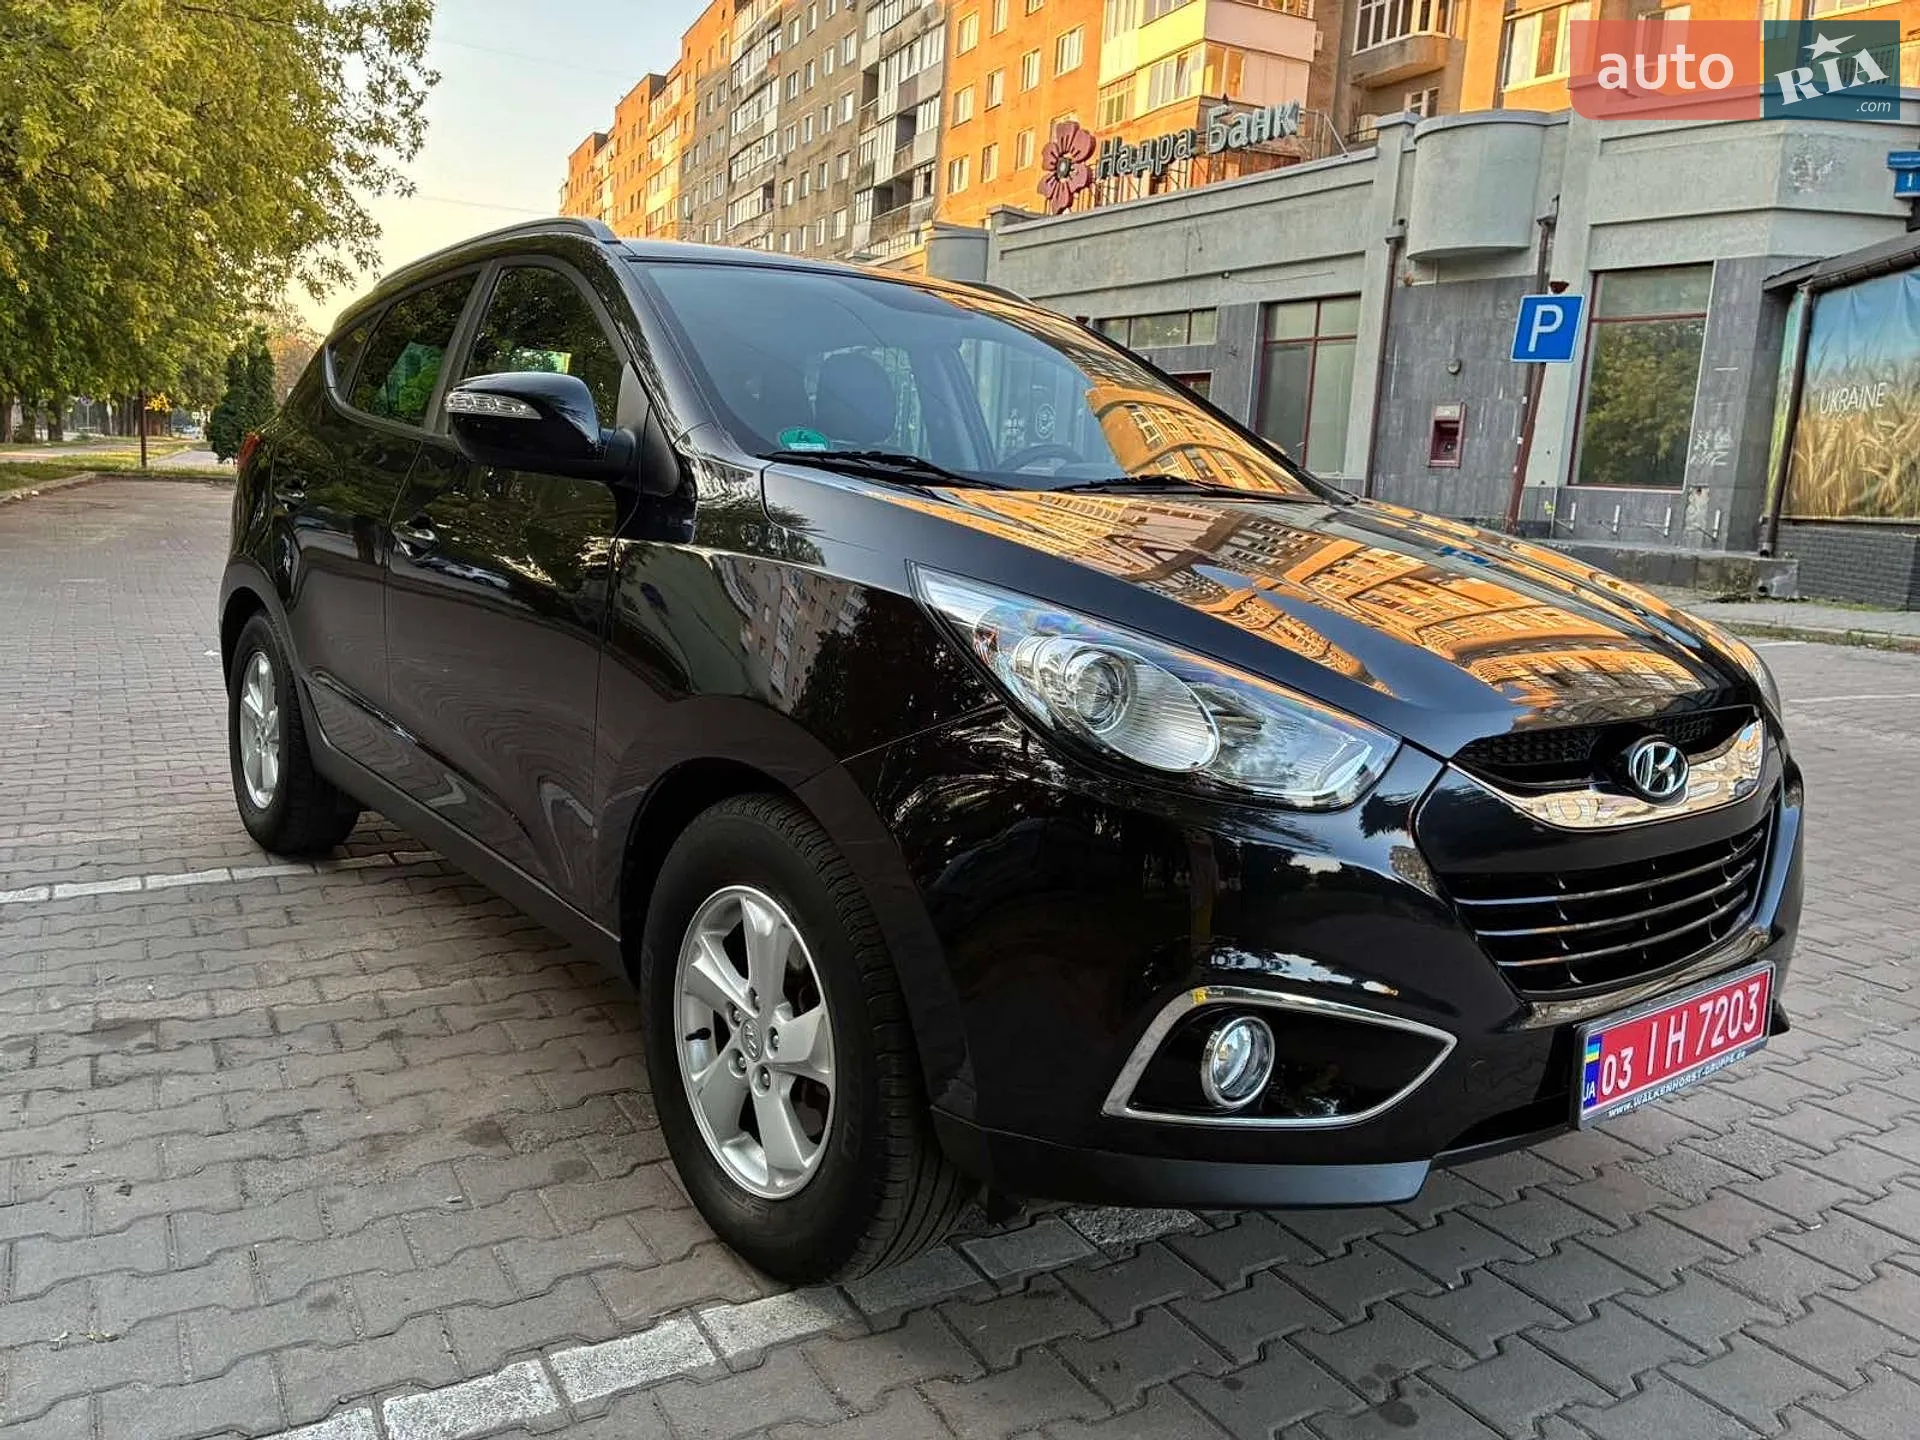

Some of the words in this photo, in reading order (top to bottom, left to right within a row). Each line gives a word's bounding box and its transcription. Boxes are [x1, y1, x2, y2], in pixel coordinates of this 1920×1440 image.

[1098, 128, 1196, 178] Надра
[1206, 101, 1301, 154] Банк
[1528, 304, 1563, 352] P
[1820, 382, 1887, 414] UKRAINE
[1601, 1046, 1634, 1096] 03
[1647, 1010, 1689, 1076] IH
[1695, 983, 1760, 1055] 7203
